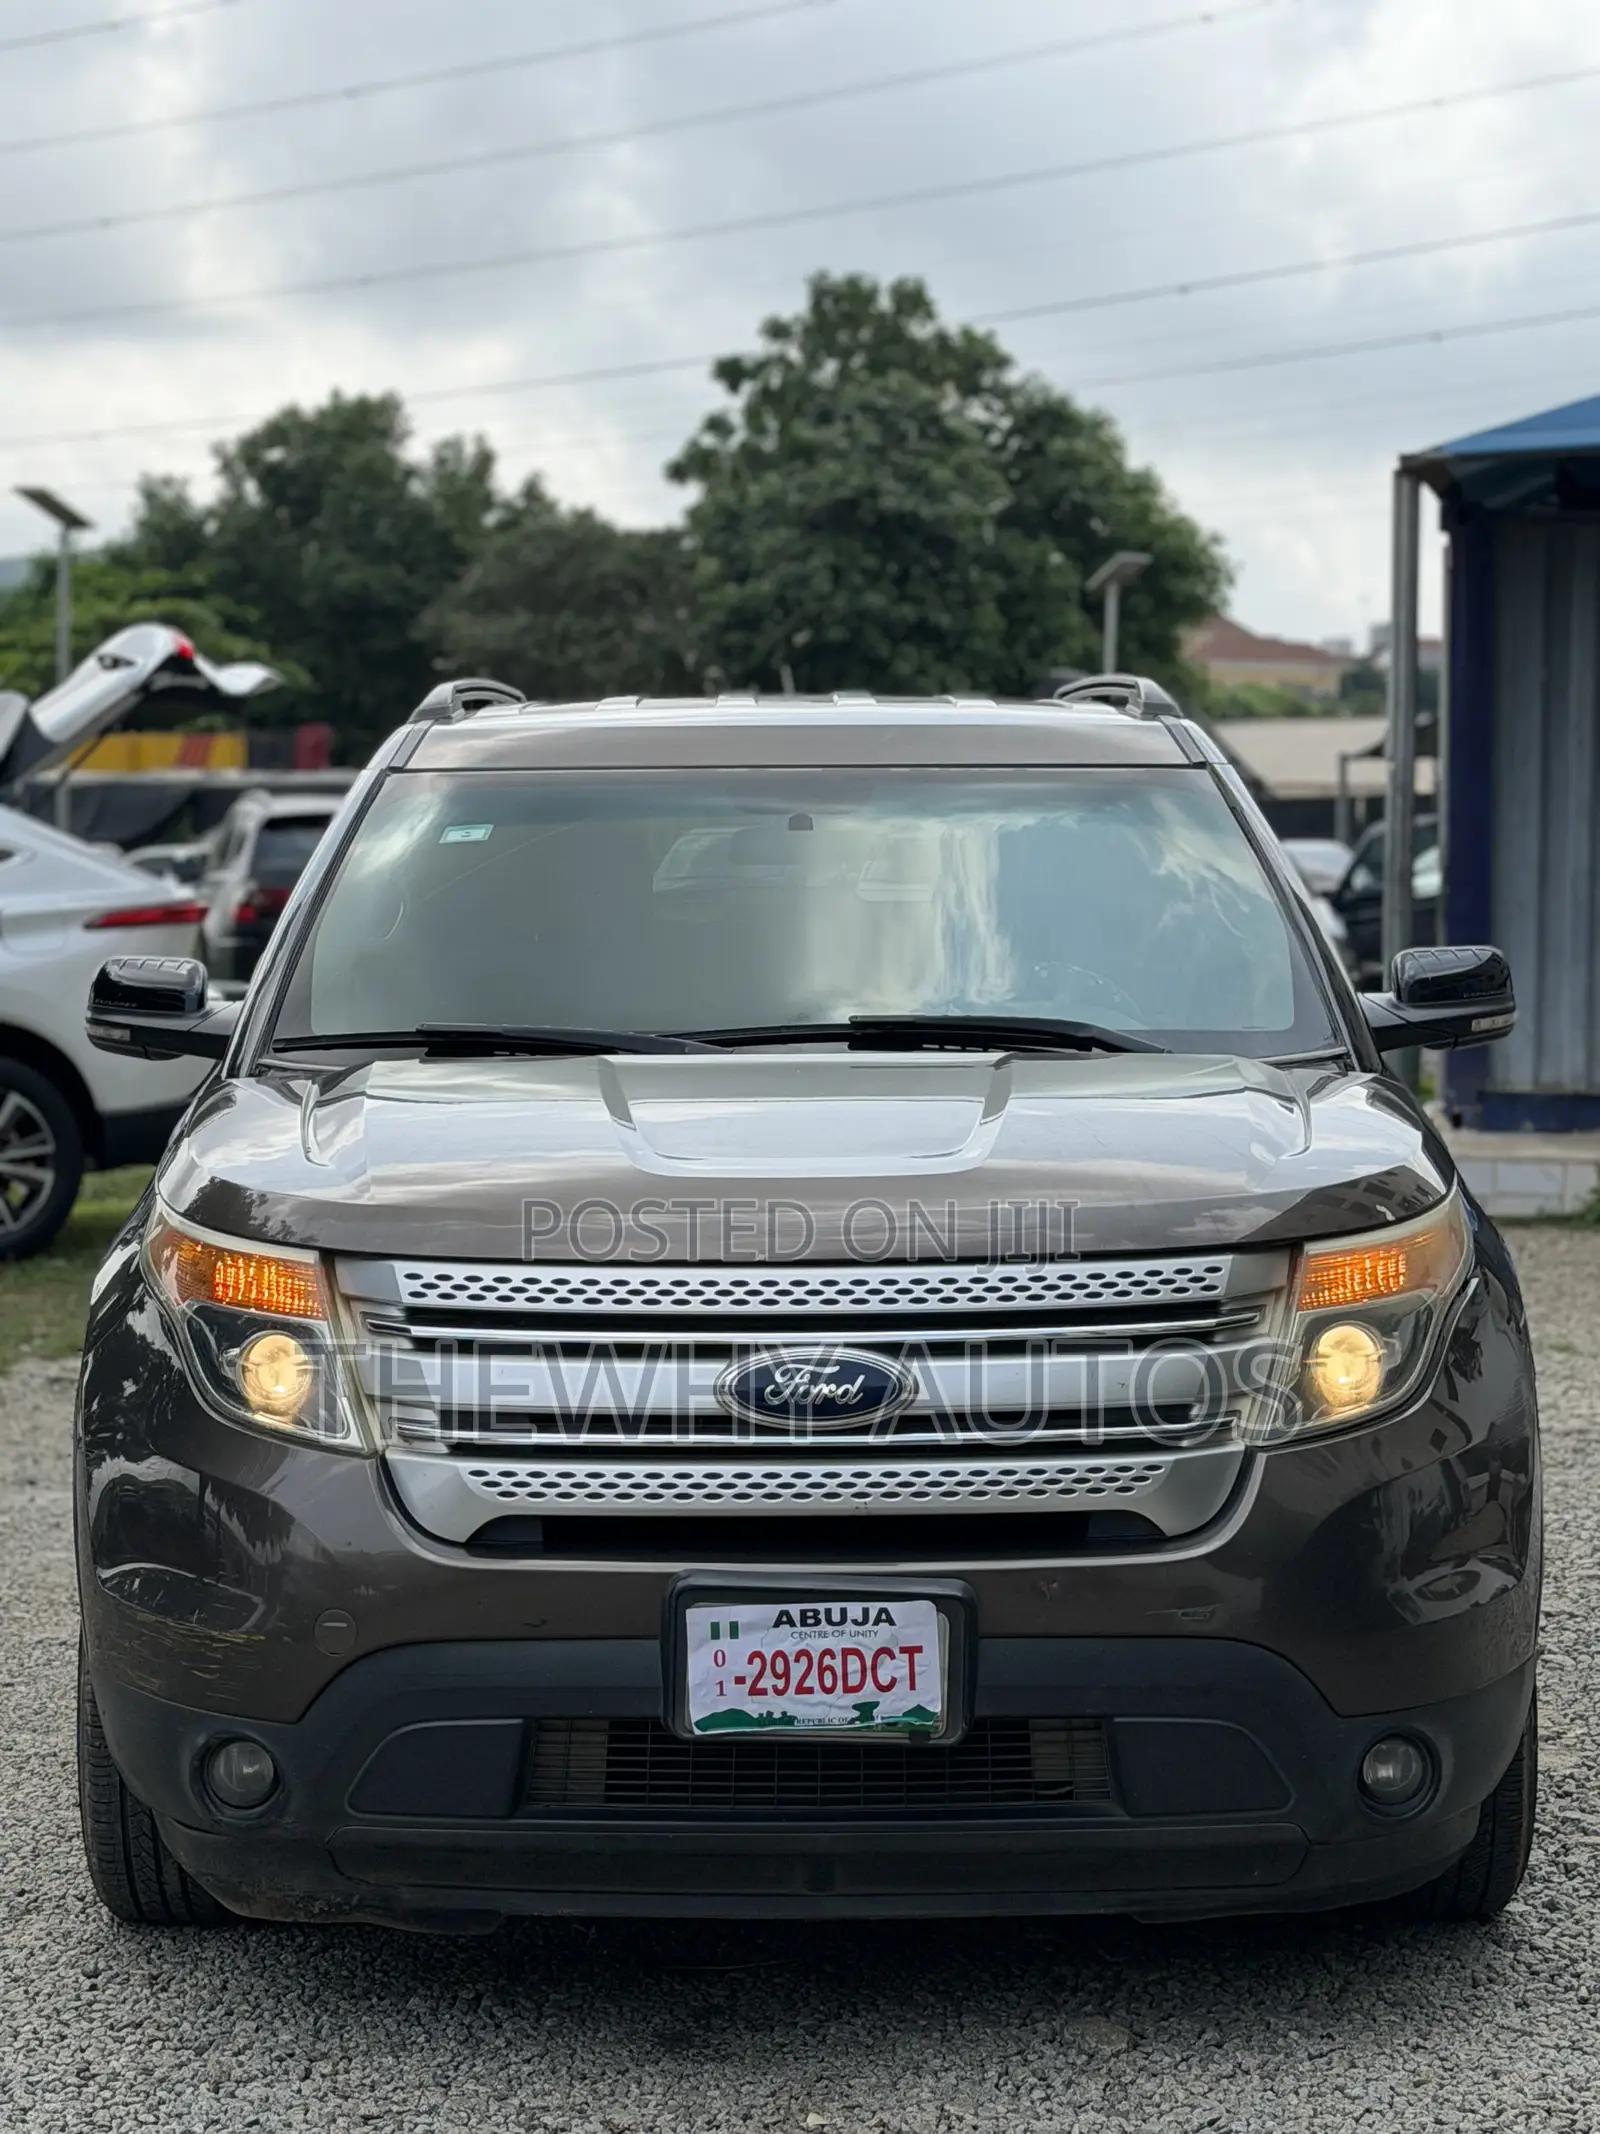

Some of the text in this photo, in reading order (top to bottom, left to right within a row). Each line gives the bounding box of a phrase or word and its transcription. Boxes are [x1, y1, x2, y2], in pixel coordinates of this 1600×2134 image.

[764, 1363, 866, 1406] Ford
[771, 1606, 897, 1629] ABUJA
[790, 1628, 879, 1640] CENTRE OF UNITY
